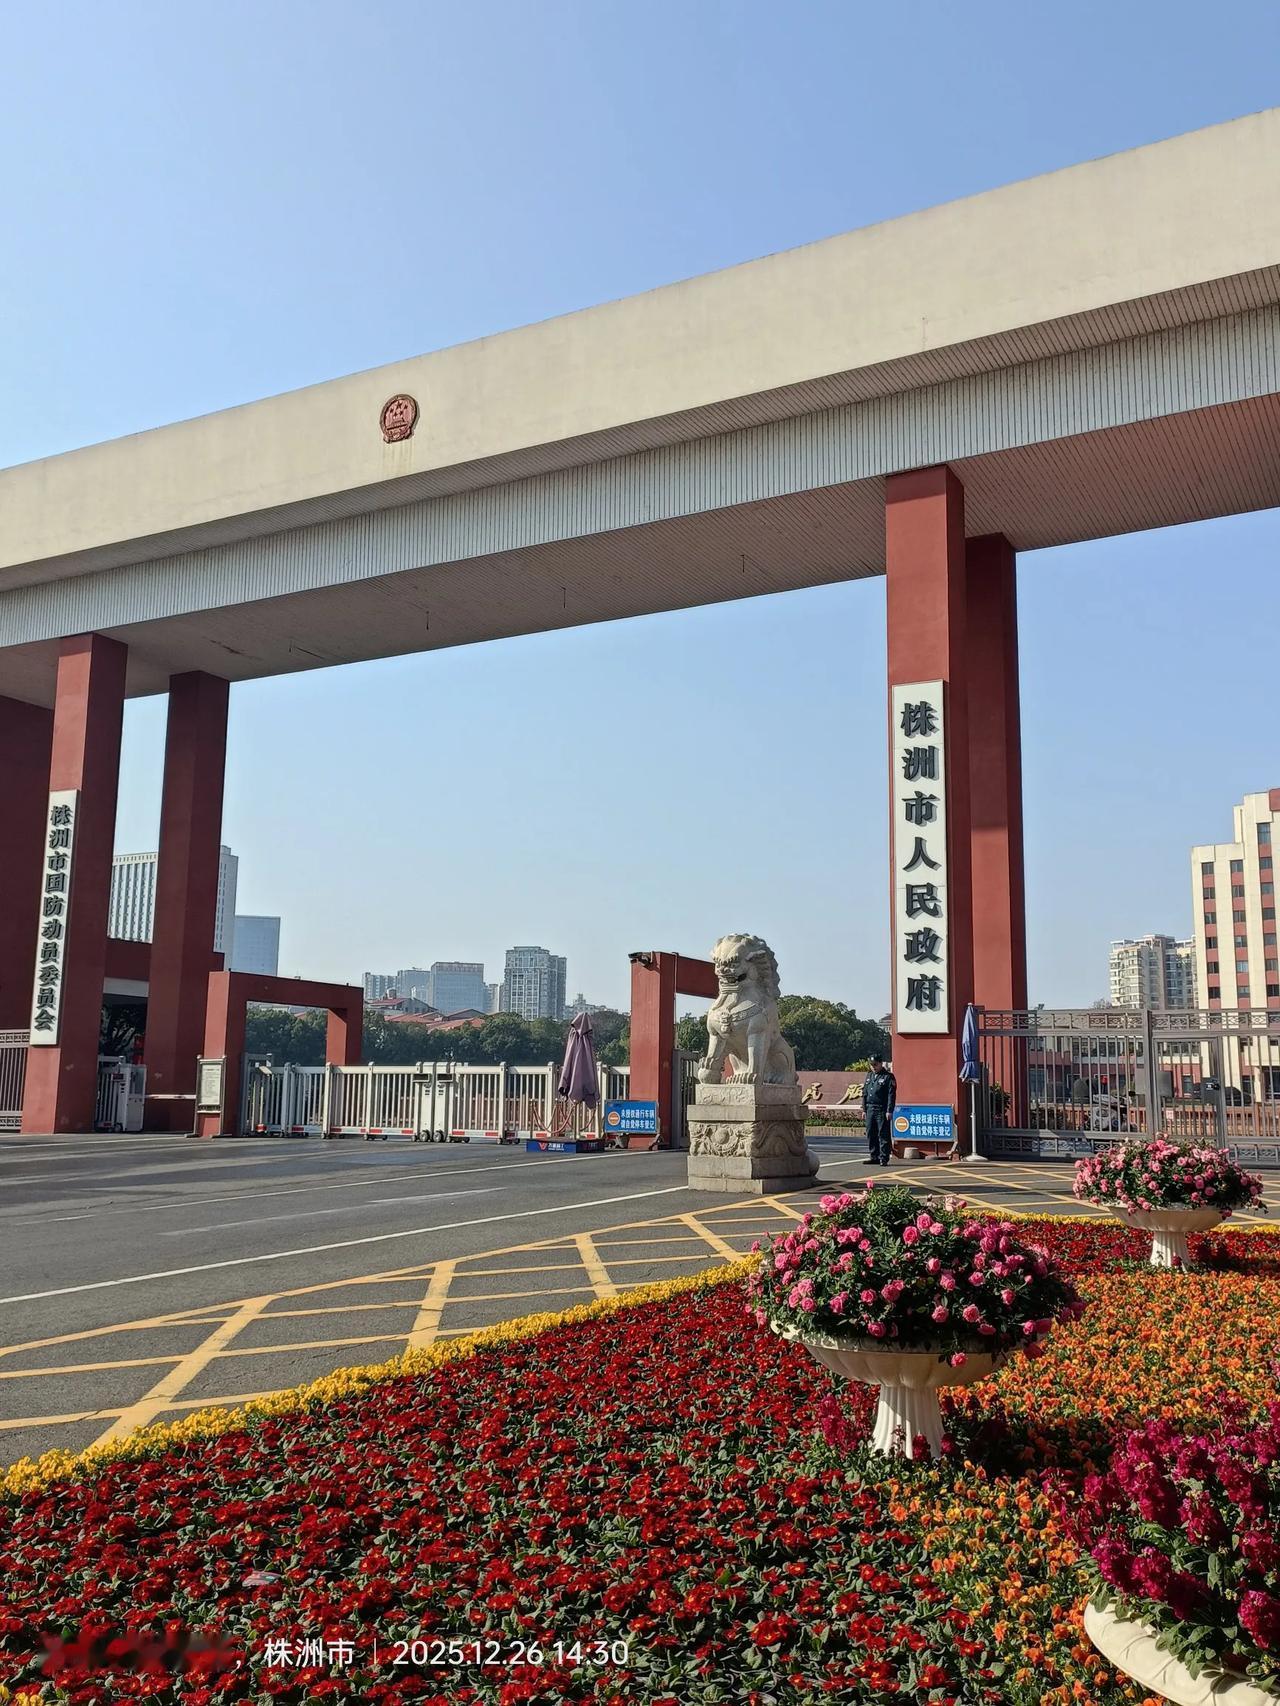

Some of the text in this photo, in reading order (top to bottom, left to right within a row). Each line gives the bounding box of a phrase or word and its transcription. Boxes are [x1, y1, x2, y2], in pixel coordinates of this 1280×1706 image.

[901, 701, 944, 1011] 株洲市人民政府
[34, 804, 73, 1031] 株洲市国防动员委员会
[910, 1114, 950, 1124] 未授权通行车辆
[910, 1125, 951, 1136] 请自觉停车登记
